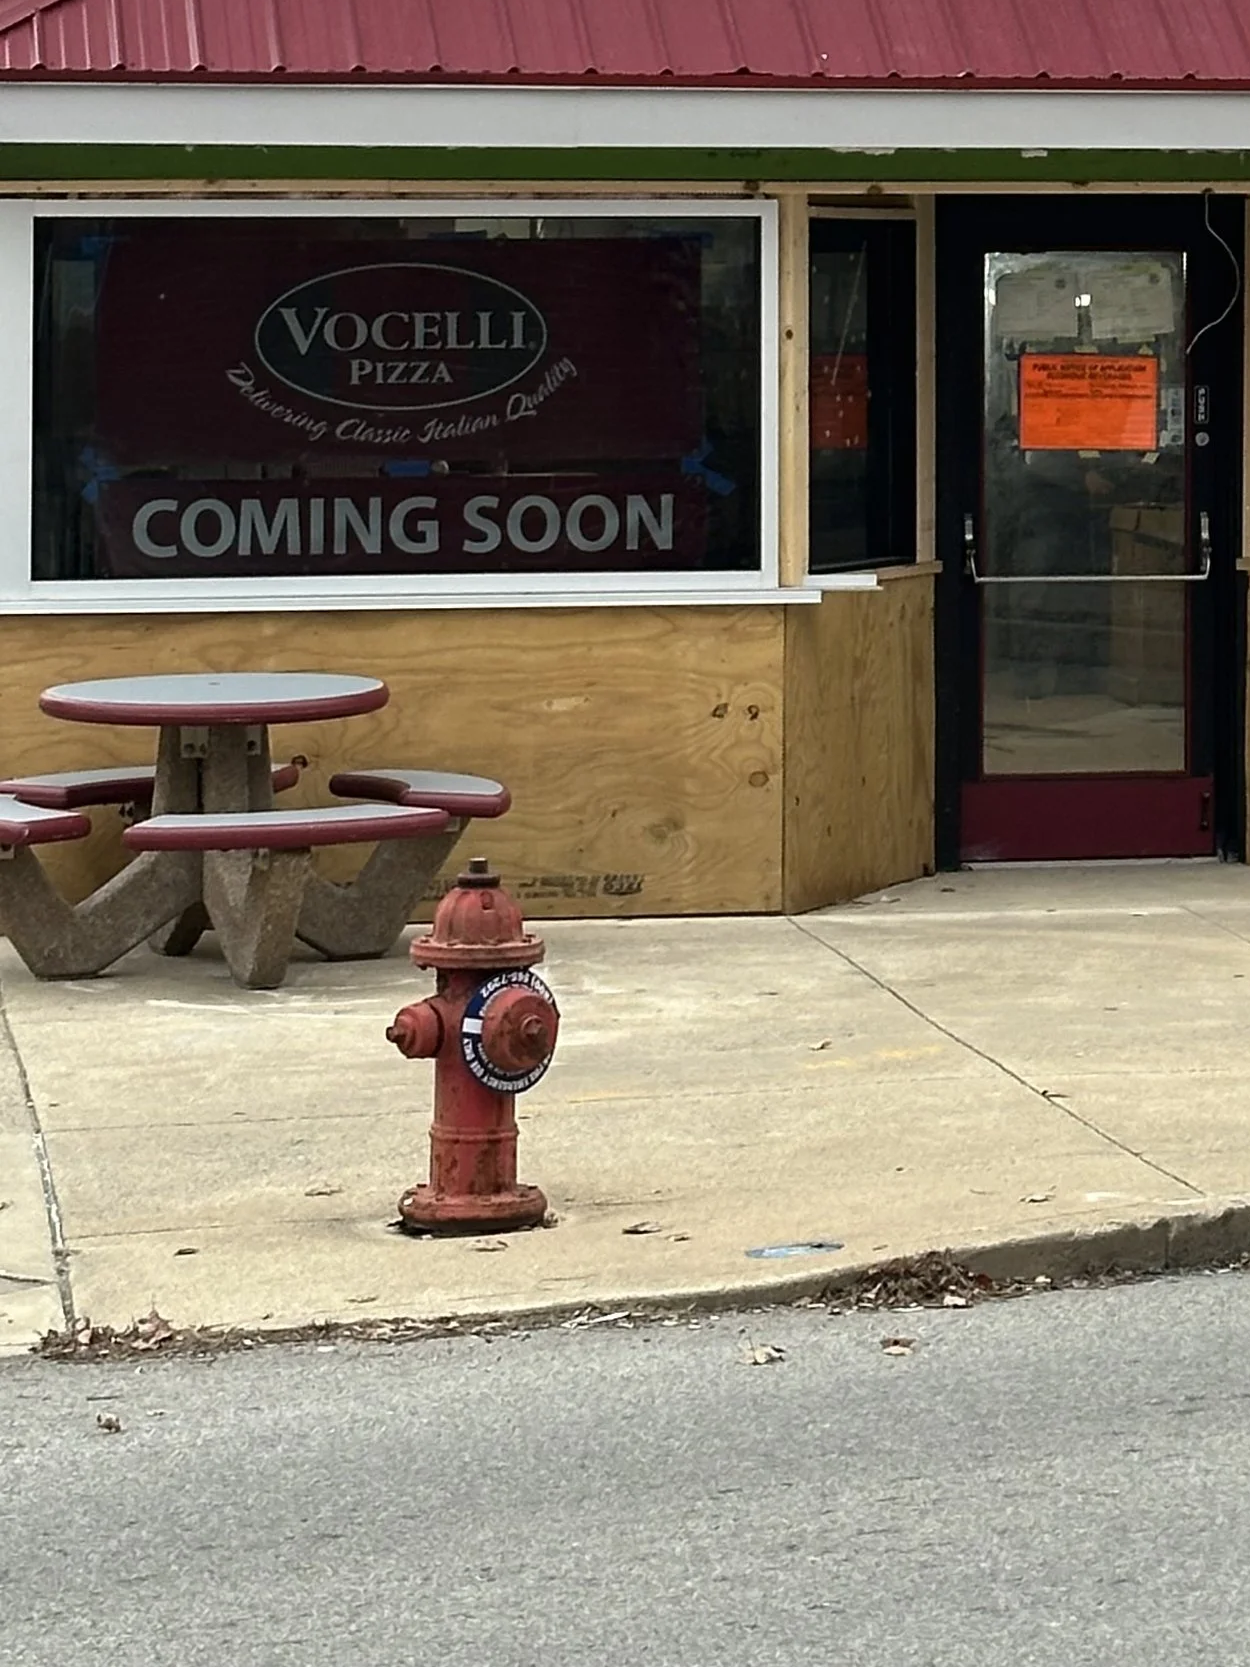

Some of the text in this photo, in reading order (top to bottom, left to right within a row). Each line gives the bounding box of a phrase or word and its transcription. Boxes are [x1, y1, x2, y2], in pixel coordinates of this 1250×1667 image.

[277, 305, 527, 356] VOCELLI
[225, 356, 578, 444] Delivering Classic Italian Quality
[349, 358, 454, 386] PIZZA
[132, 493, 674, 558] COMING SOON
